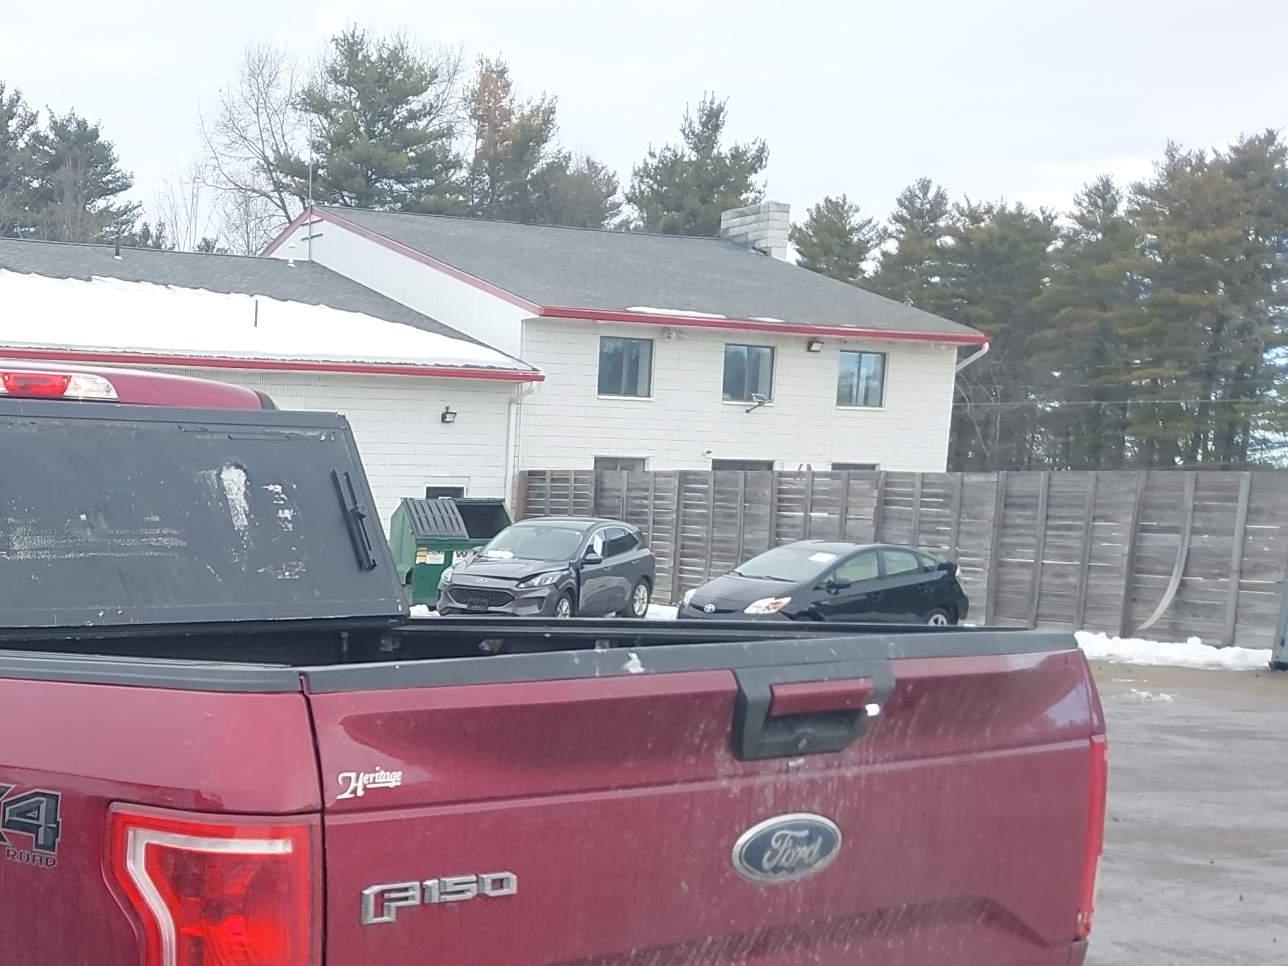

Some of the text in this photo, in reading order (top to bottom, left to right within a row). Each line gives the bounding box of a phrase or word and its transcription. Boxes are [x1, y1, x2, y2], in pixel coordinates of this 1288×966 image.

[336, 766, 403, 800] Heritage
[5, 846, 58, 869] ROAD
[761, 829, 823, 871] Ford
[359, 870, 518, 926] F150
